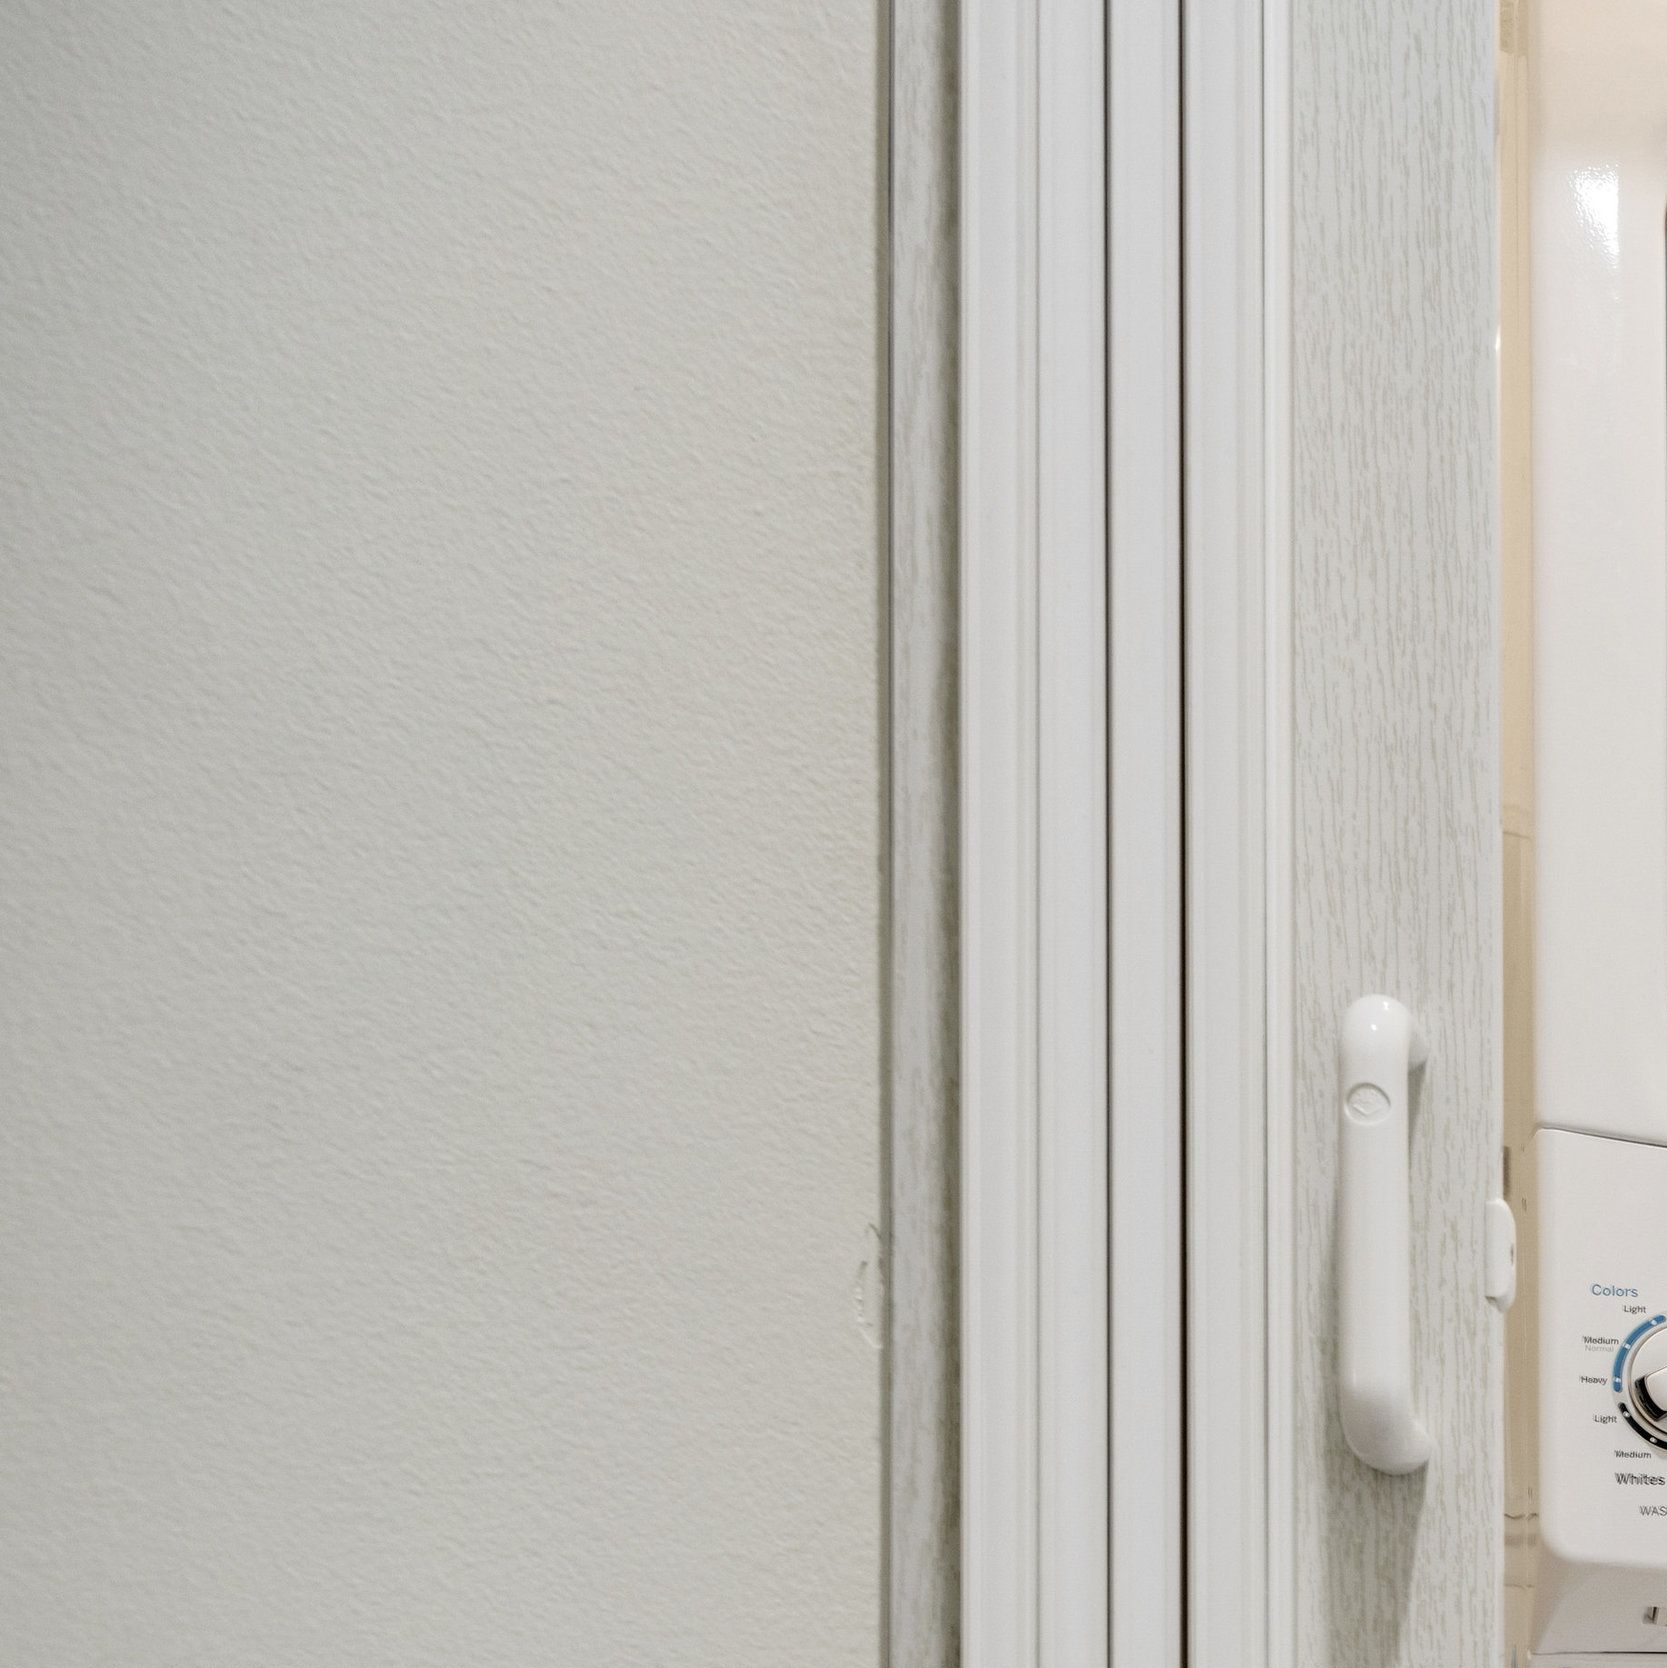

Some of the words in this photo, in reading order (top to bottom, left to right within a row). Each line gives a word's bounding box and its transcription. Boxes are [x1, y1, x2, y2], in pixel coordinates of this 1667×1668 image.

[1591, 1283, 1638, 1297] Colors
[1623, 1305, 1647, 1315] Light
[1584, 1336, 1619, 1345] Medium
[1580, 1375, 1607, 1385] Heavy
[1594, 1414, 1617, 1424] Light
[1614, 1450, 1651, 1458] Medium
[1615, 1473, 1666, 1485] Whites
